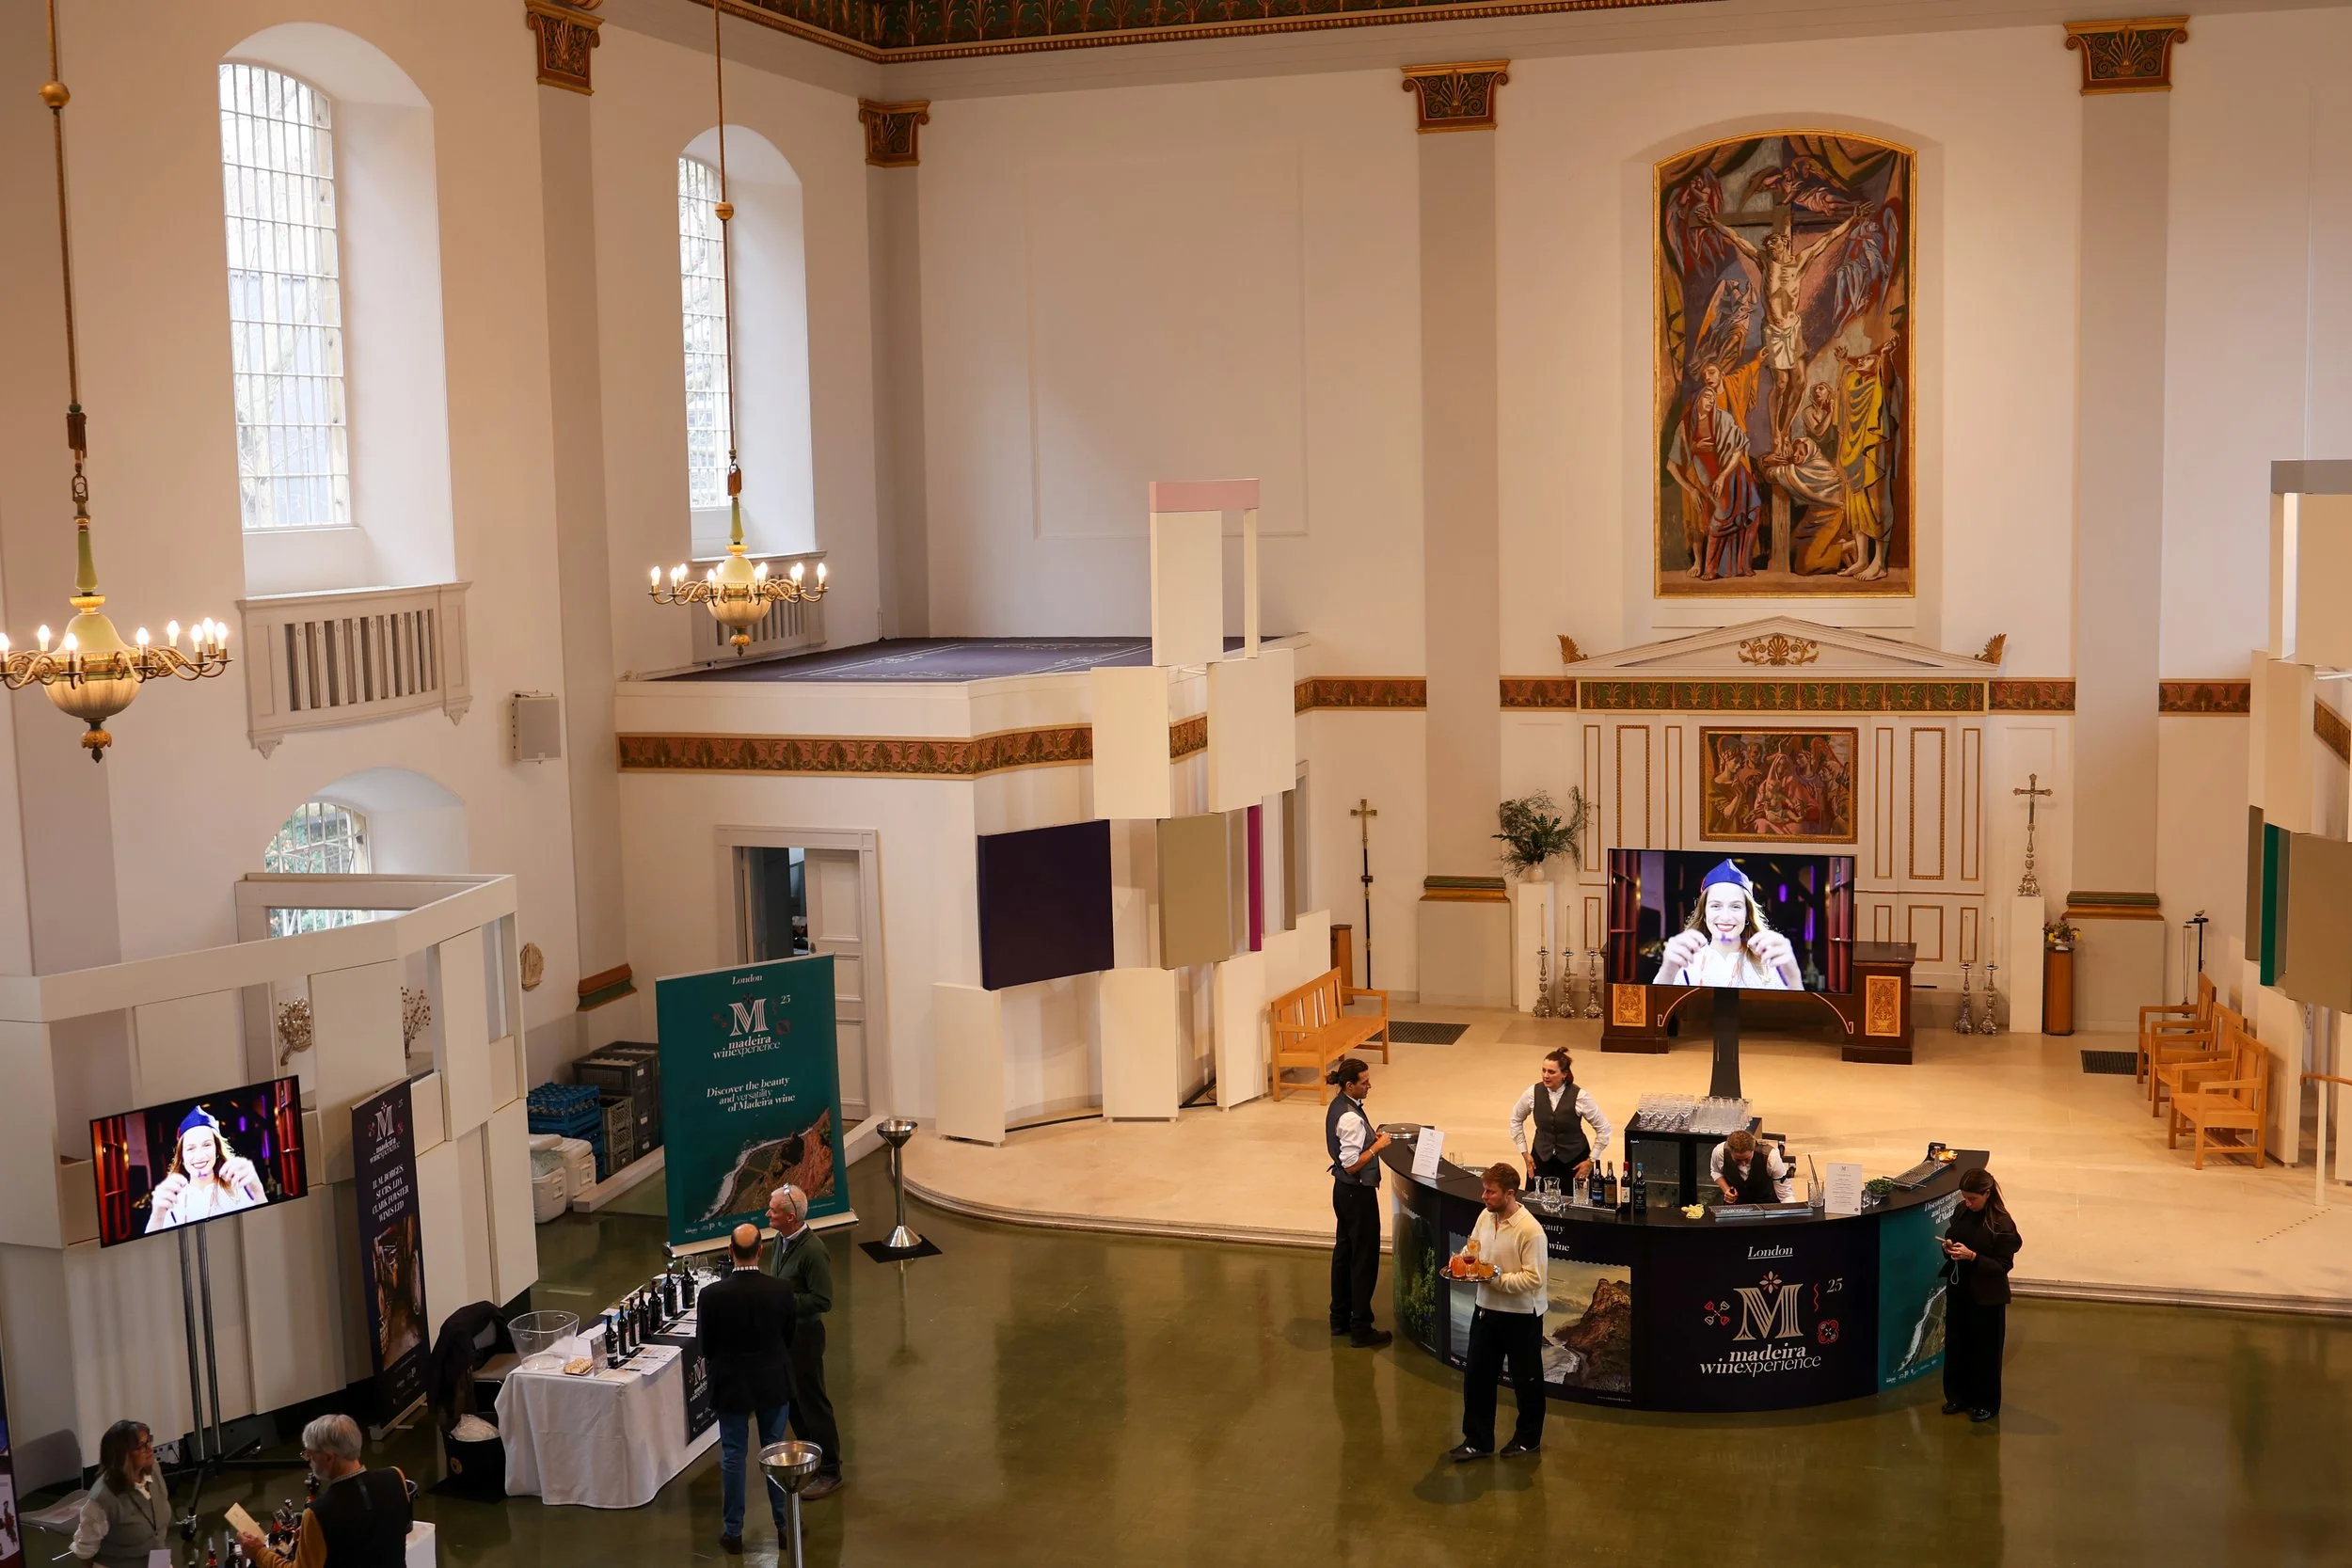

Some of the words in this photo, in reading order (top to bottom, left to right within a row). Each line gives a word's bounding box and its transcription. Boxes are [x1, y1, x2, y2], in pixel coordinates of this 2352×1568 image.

[732, 974, 763, 986] London
[780, 994, 791, 1005] 25
[727, 998, 770, 1037] M
[712, 1040, 781, 1060] winexperience
[728, 1035, 771, 1050] madeira
[707, 1086, 744, 1099] Discover
[745, 1081, 759, 1091] the
[760, 1077, 790, 1087] beauty
[719, 1093, 735, 1105] and
[736, 1088, 772, 1101] versatility
[727, 1101, 738, 1113] of
[739, 1097, 773, 1110] Madeira
[775, 1093, 796, 1103] wine
[374, 1104, 395, 1143] M
[1541, 1223, 1565, 1235] eauty
[1549, 1241, 1570, 1252] wine
[1747, 1244, 1794, 1259] London
[1826, 1277, 1843, 1293] 25
[1732, 1283, 1804, 1341] M
[1728, 1342, 1806, 1362] madeira
[1699, 1355, 1821, 1378] winexperience
